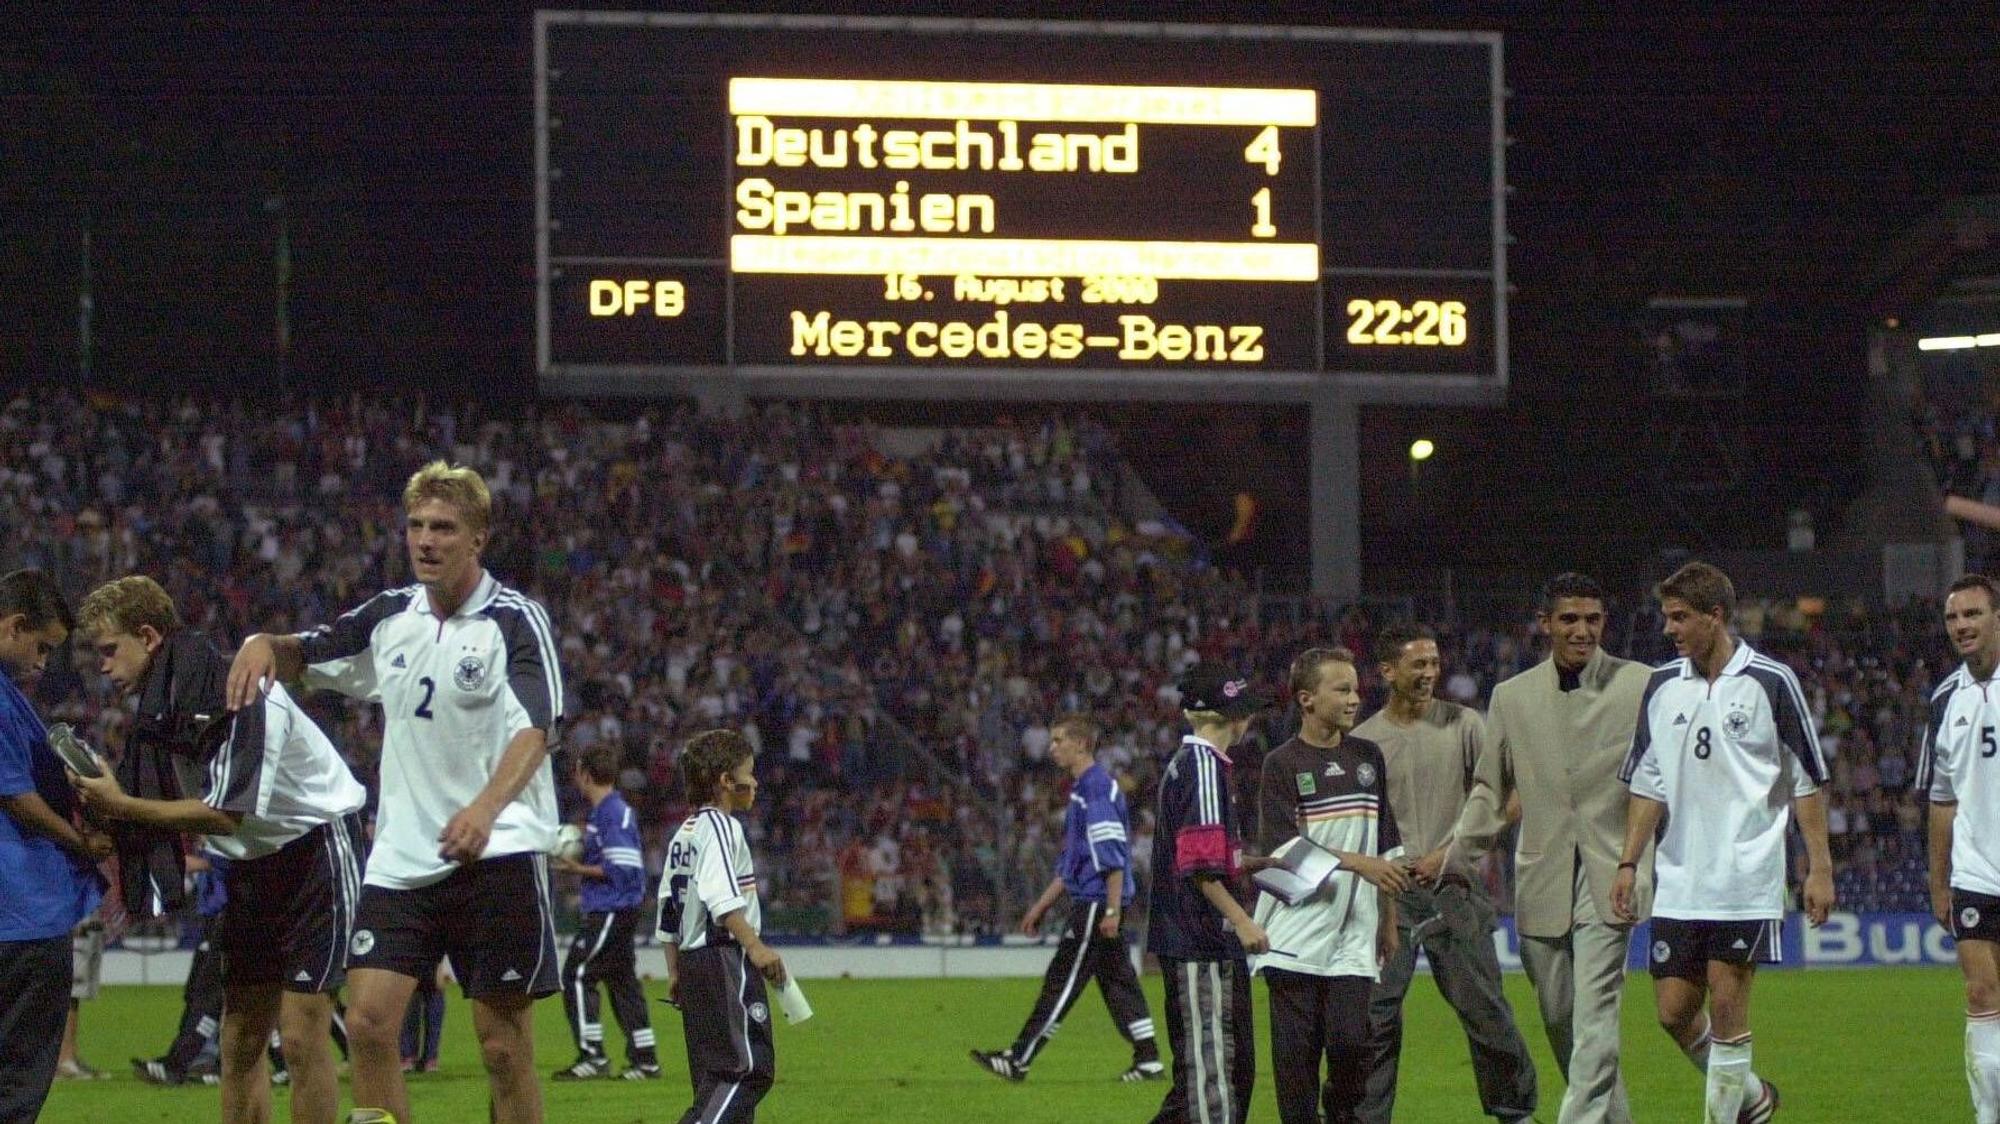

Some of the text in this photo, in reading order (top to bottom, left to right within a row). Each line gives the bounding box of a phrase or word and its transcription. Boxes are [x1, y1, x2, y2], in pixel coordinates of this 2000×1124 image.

[736, 116, 1281, 176] Deutschland 4
[736, 178, 1277, 237] Spanien 1
[589, 280, 685, 317] DFB
[885, 275, 1159, 305] 16. August 2000
[791, 309, 1264, 362] Mercedes-Benz
[1347, 300, 1467, 346] 22:26
[414, 676, 435, 720] 2
[1694, 726, 1711, 760] 8
[1981, 726, 1998, 758] 5
